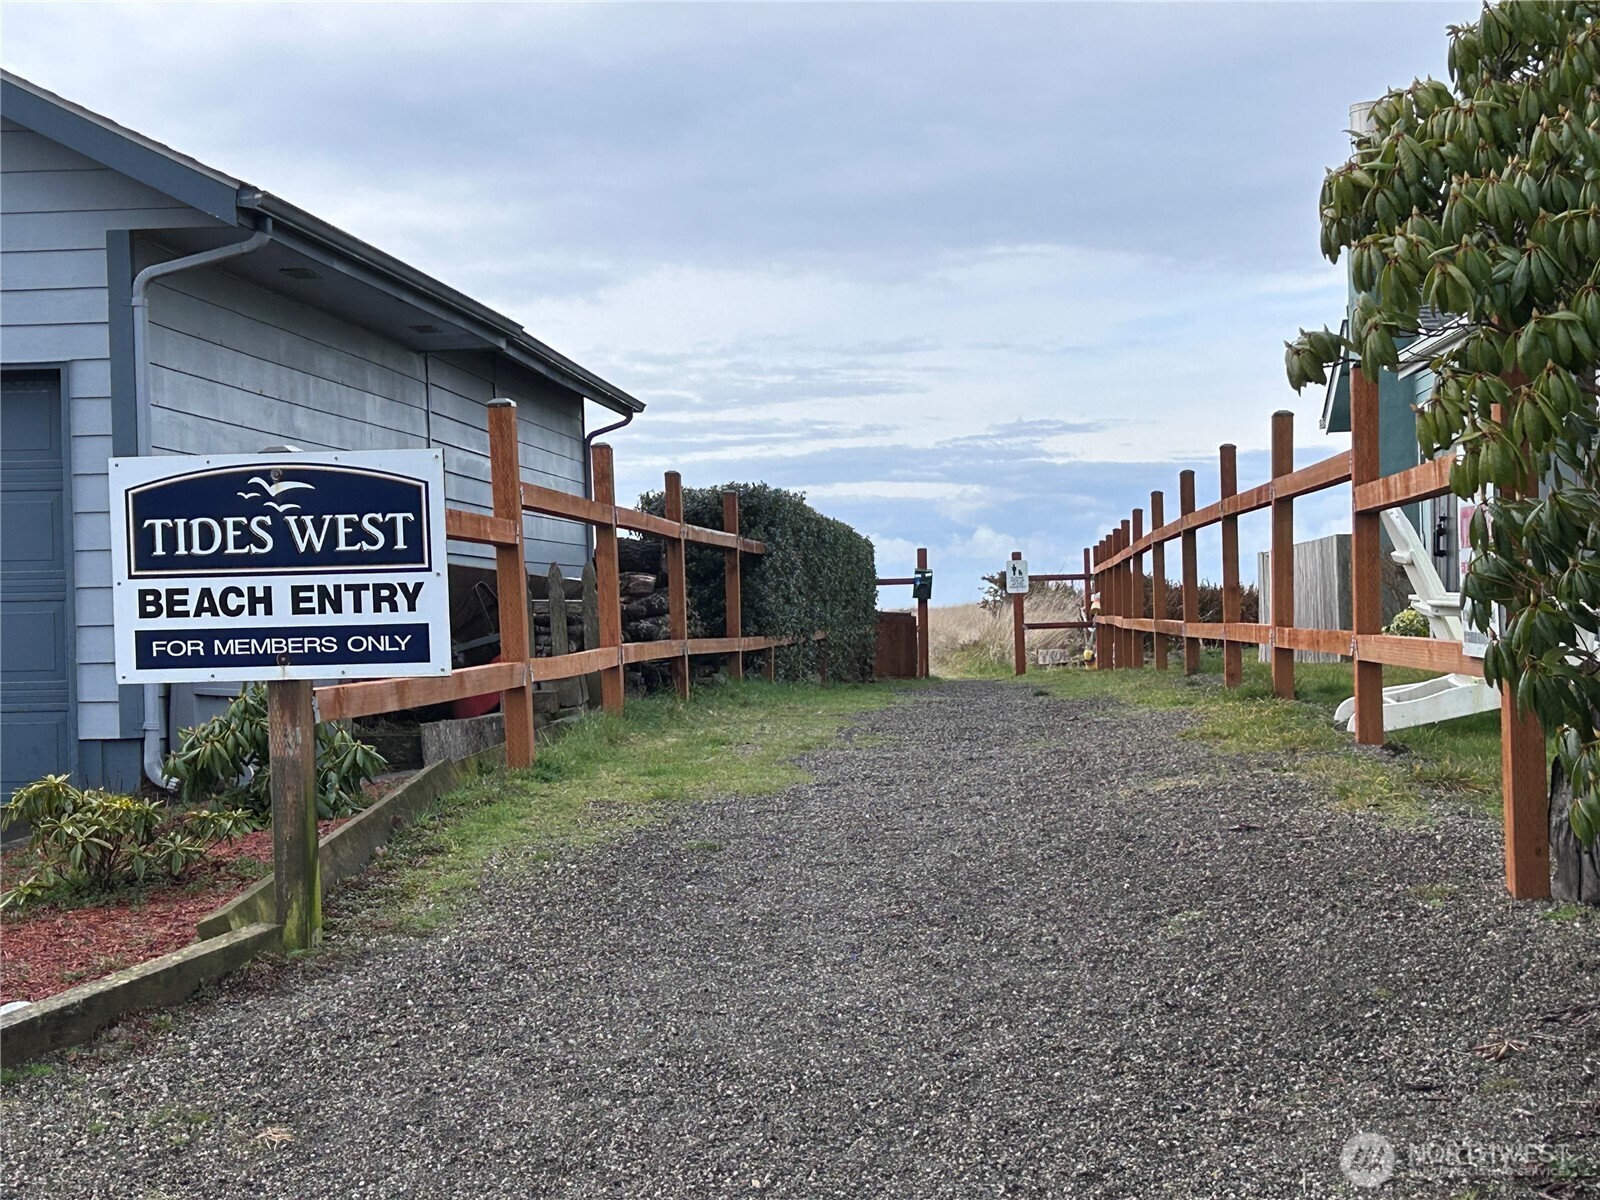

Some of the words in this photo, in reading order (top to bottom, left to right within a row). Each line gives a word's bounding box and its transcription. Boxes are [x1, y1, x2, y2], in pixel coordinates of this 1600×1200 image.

[143, 516, 273, 556] TIDES
[284, 512, 414, 553] WEST
[138, 585, 273, 619] BEACH
[290, 581, 425, 615] ENTRY
[152, 640, 205, 657] FOR
[213, 636, 338, 656] MEMBERS
[347, 634, 413, 653] ONLY
